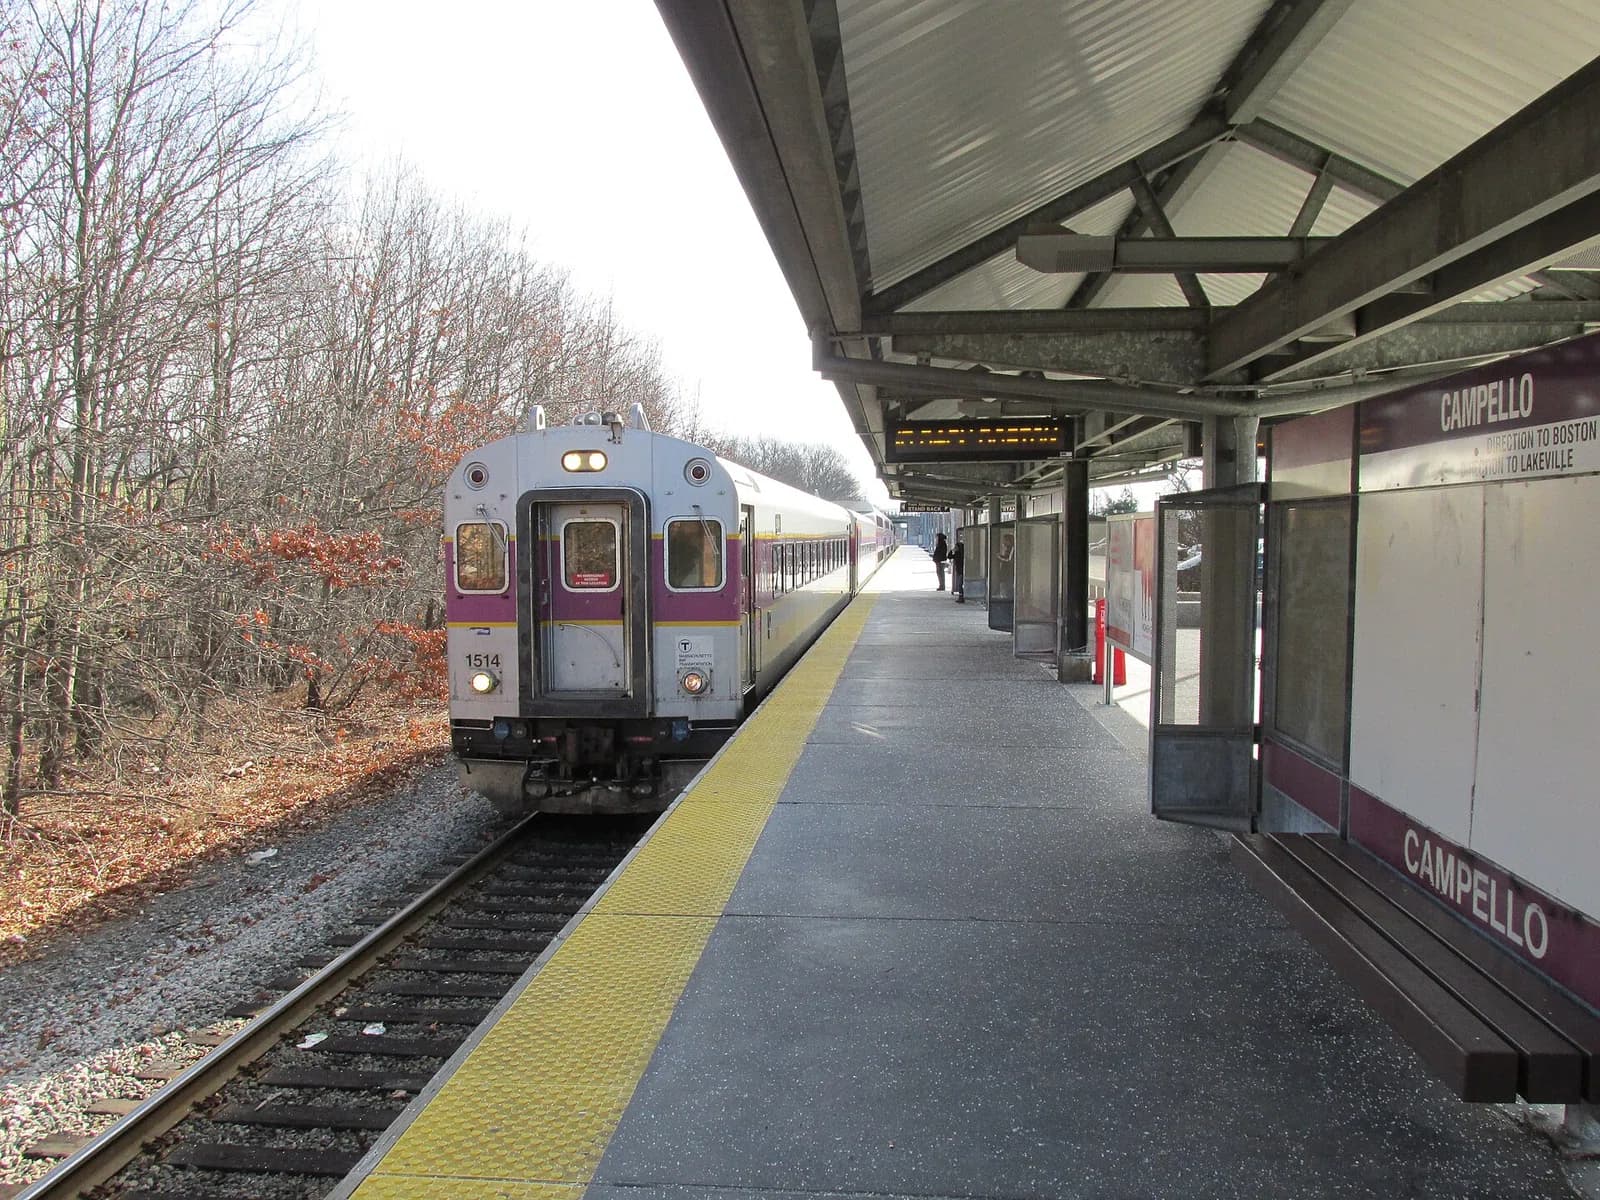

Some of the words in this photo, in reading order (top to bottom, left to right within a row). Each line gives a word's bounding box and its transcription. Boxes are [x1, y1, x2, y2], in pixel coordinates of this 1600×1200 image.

[1441, 373, 1533, 432] CAMPELLO
[1486, 431, 1534, 453] DIRECTION
[1537, 428, 1549, 447] TO
[1553, 421, 1597, 445] BOSTON
[1507, 455, 1518, 473] TO
[1521, 449, 1573, 472] LAKEVILLE
[465, 654, 501, 668] 1514
[1404, 829, 1548, 959] CAMPELLO
